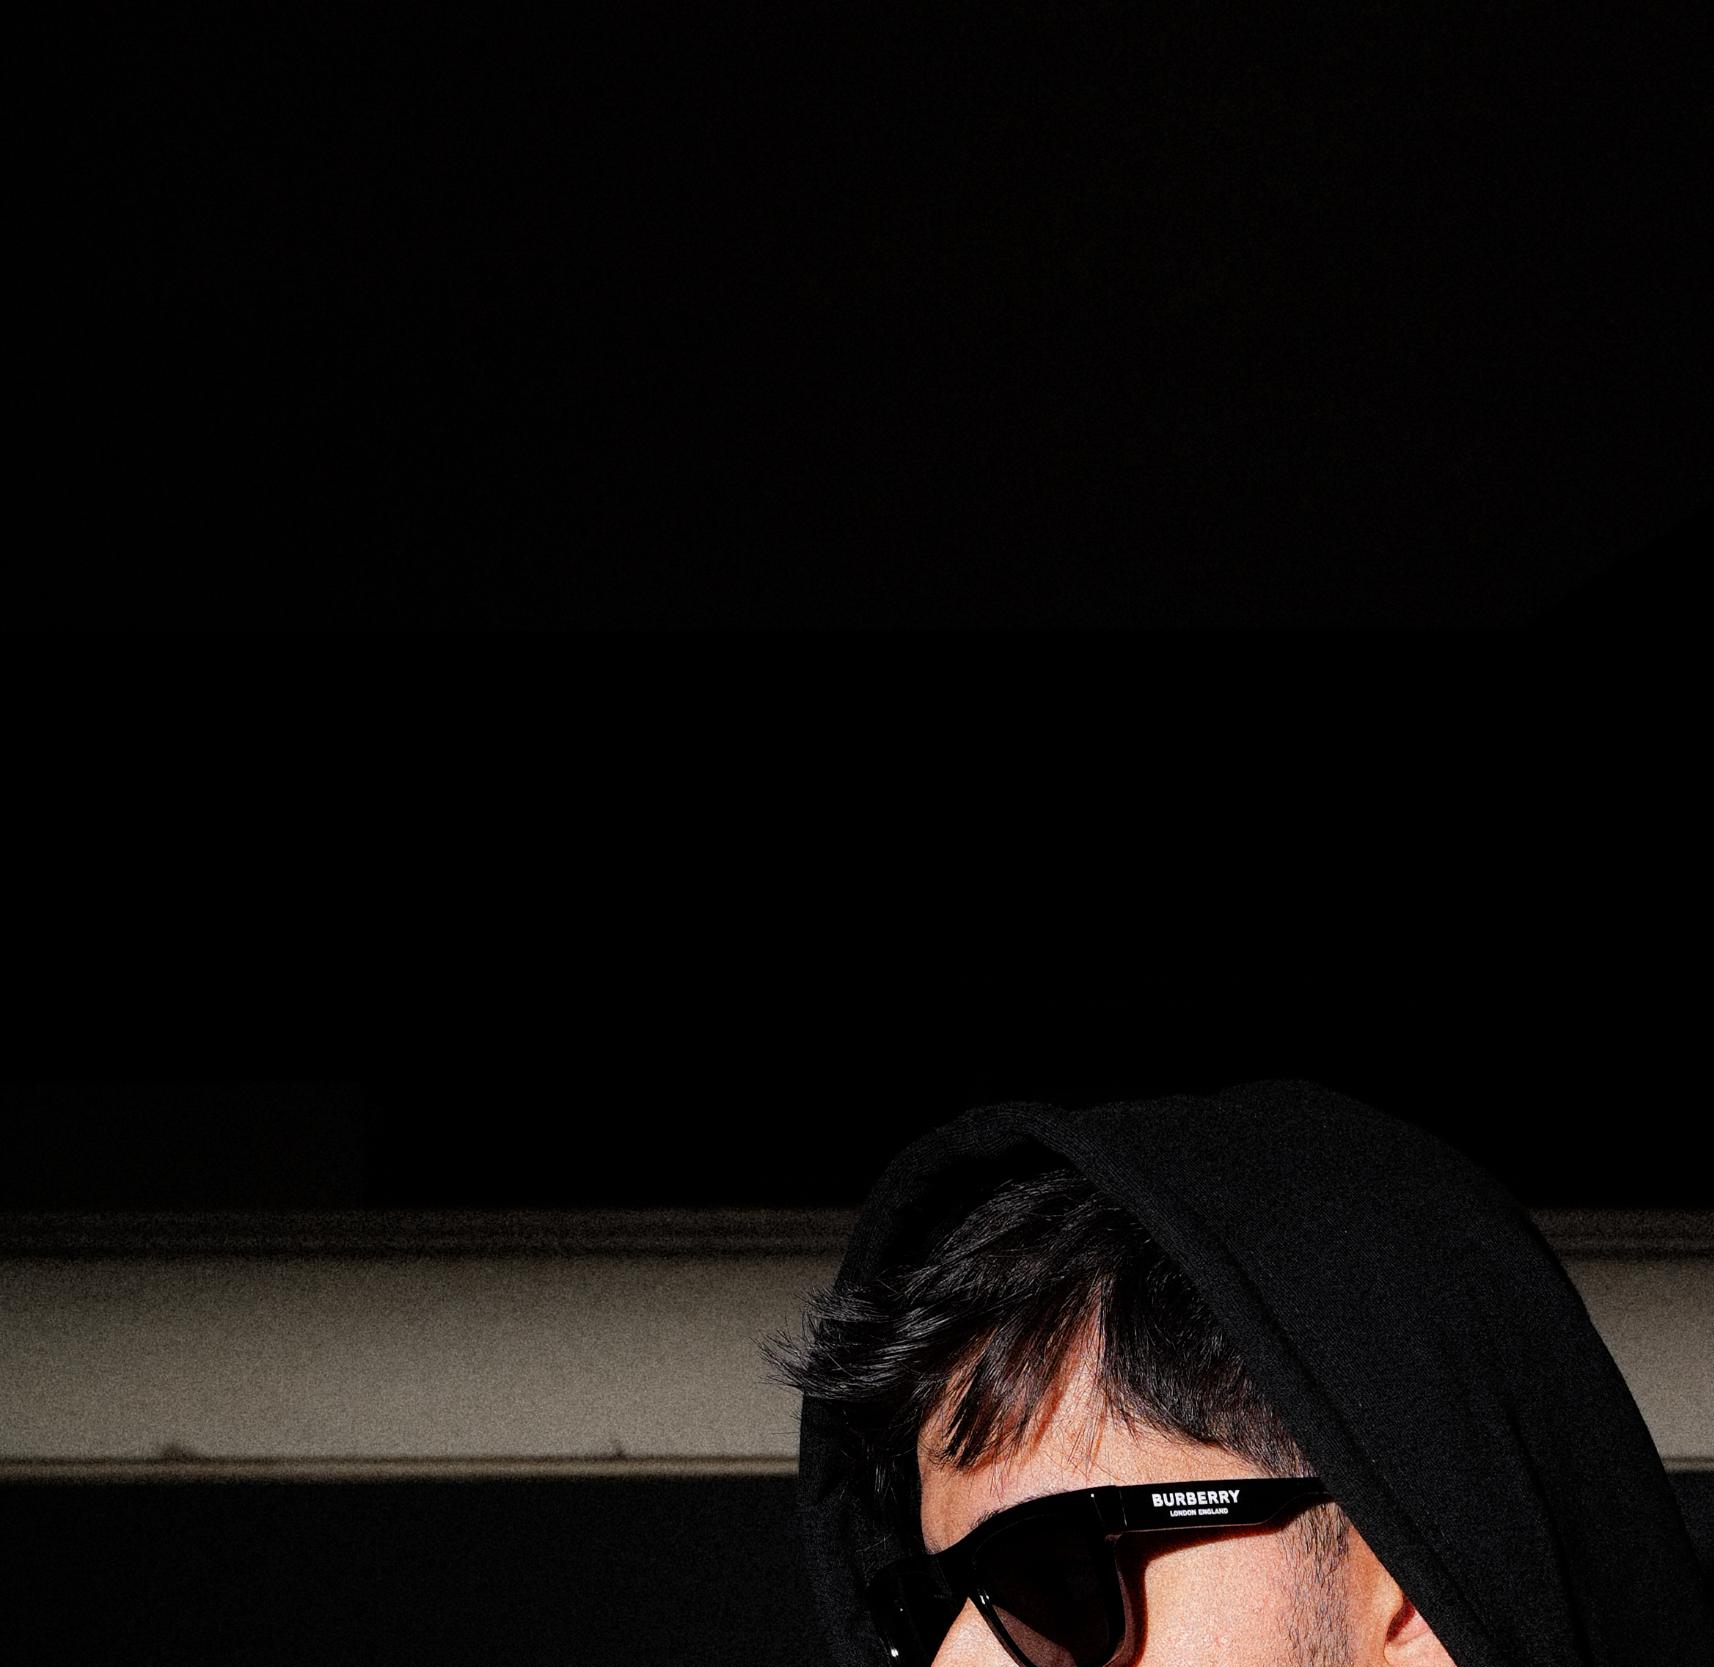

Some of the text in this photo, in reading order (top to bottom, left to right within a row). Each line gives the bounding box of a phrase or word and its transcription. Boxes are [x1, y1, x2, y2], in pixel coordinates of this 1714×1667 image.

[1152, 1490, 1240, 1507] BURBERRY
[1170, 1507, 1229, 1517] LONDON ENGLAND
